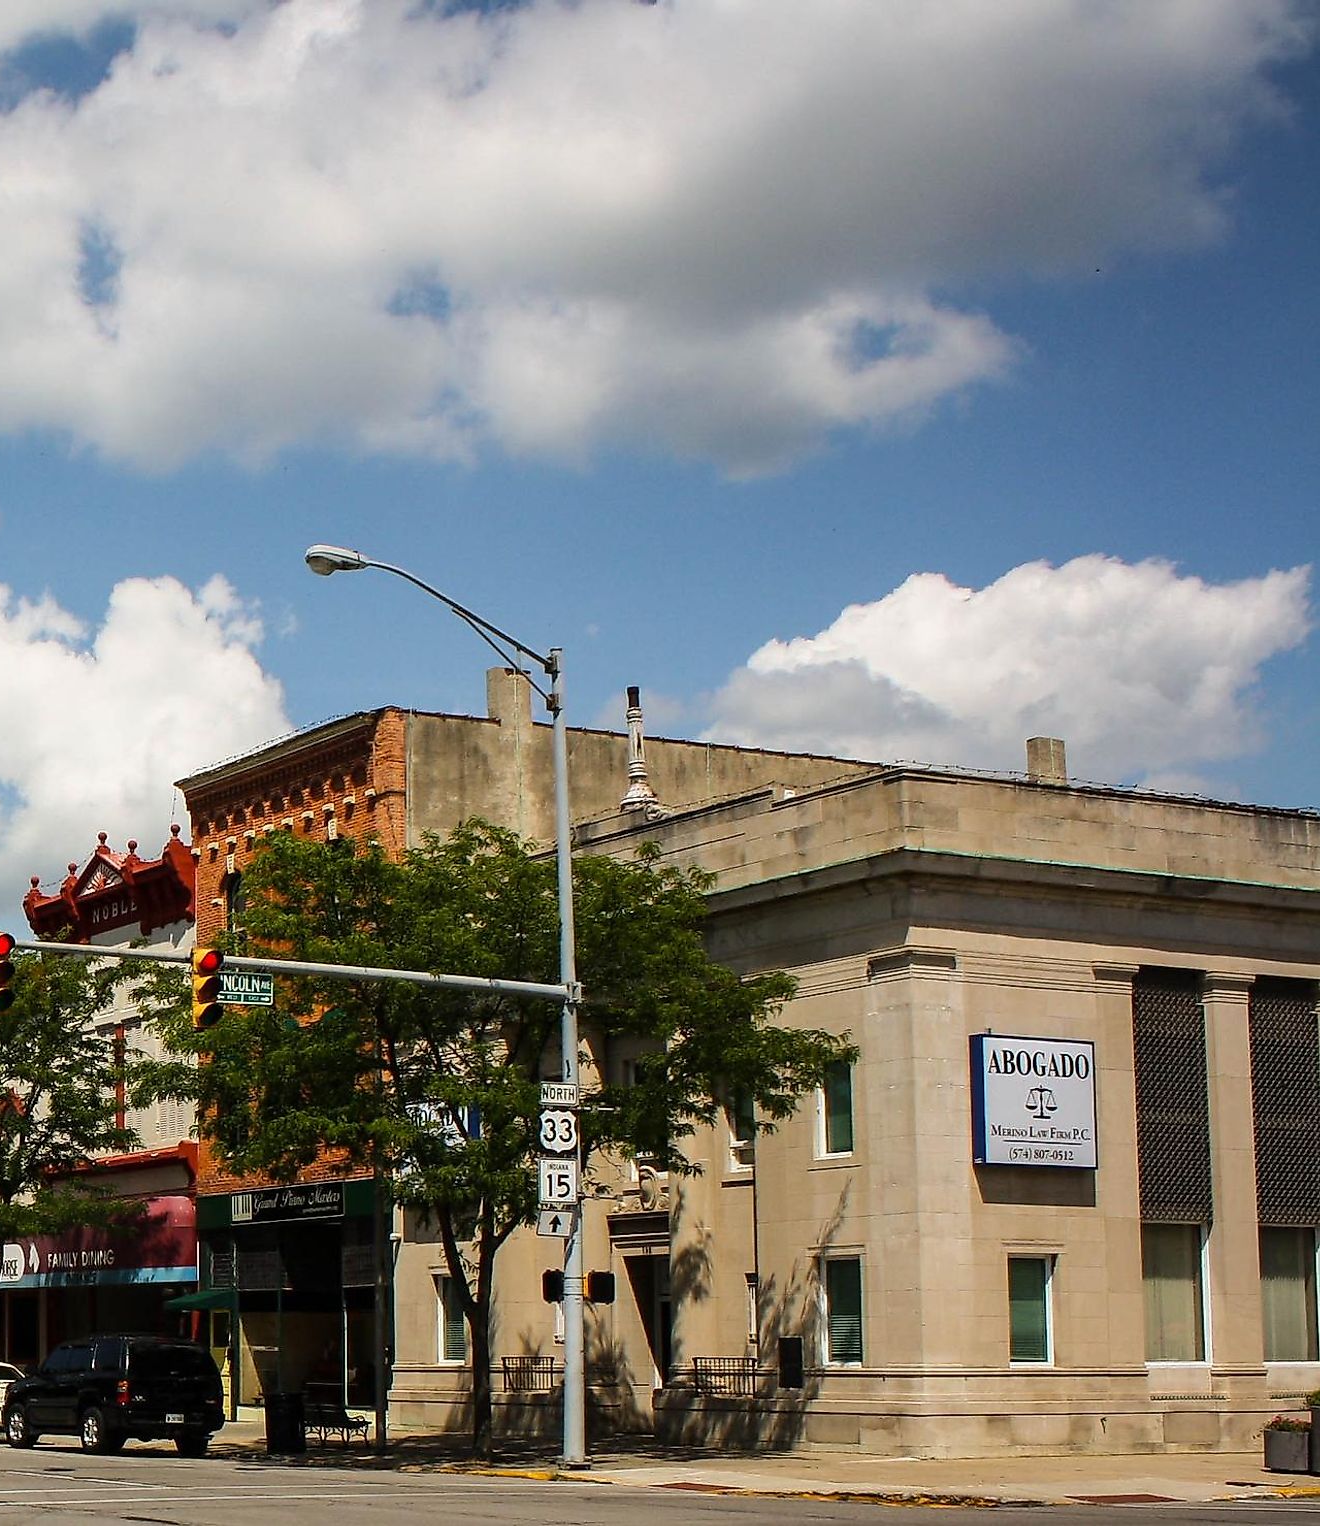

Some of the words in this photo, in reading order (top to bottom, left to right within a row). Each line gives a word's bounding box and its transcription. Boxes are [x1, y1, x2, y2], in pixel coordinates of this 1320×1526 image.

[92, 900, 138, 923] NOBLE
[988, 1049, 1090, 1079] ABOGADO
[542, 1087, 575, 1099] NORTH
[543, 1118, 573, 1142] 33
[1073, 1128, 1091, 1141] P.C.
[1009, 1147, 1032, 1161] (574)
[1033, 1149, 1074, 1161] 807-0512
[547, 1163, 569, 1171] INDIANA
[547, 1174, 570, 1198] 15
[253, 1193, 279, 1216] Grand
[47, 1252, 79, 1268] FAMILY
[81, 1249, 115, 1267] DINING
